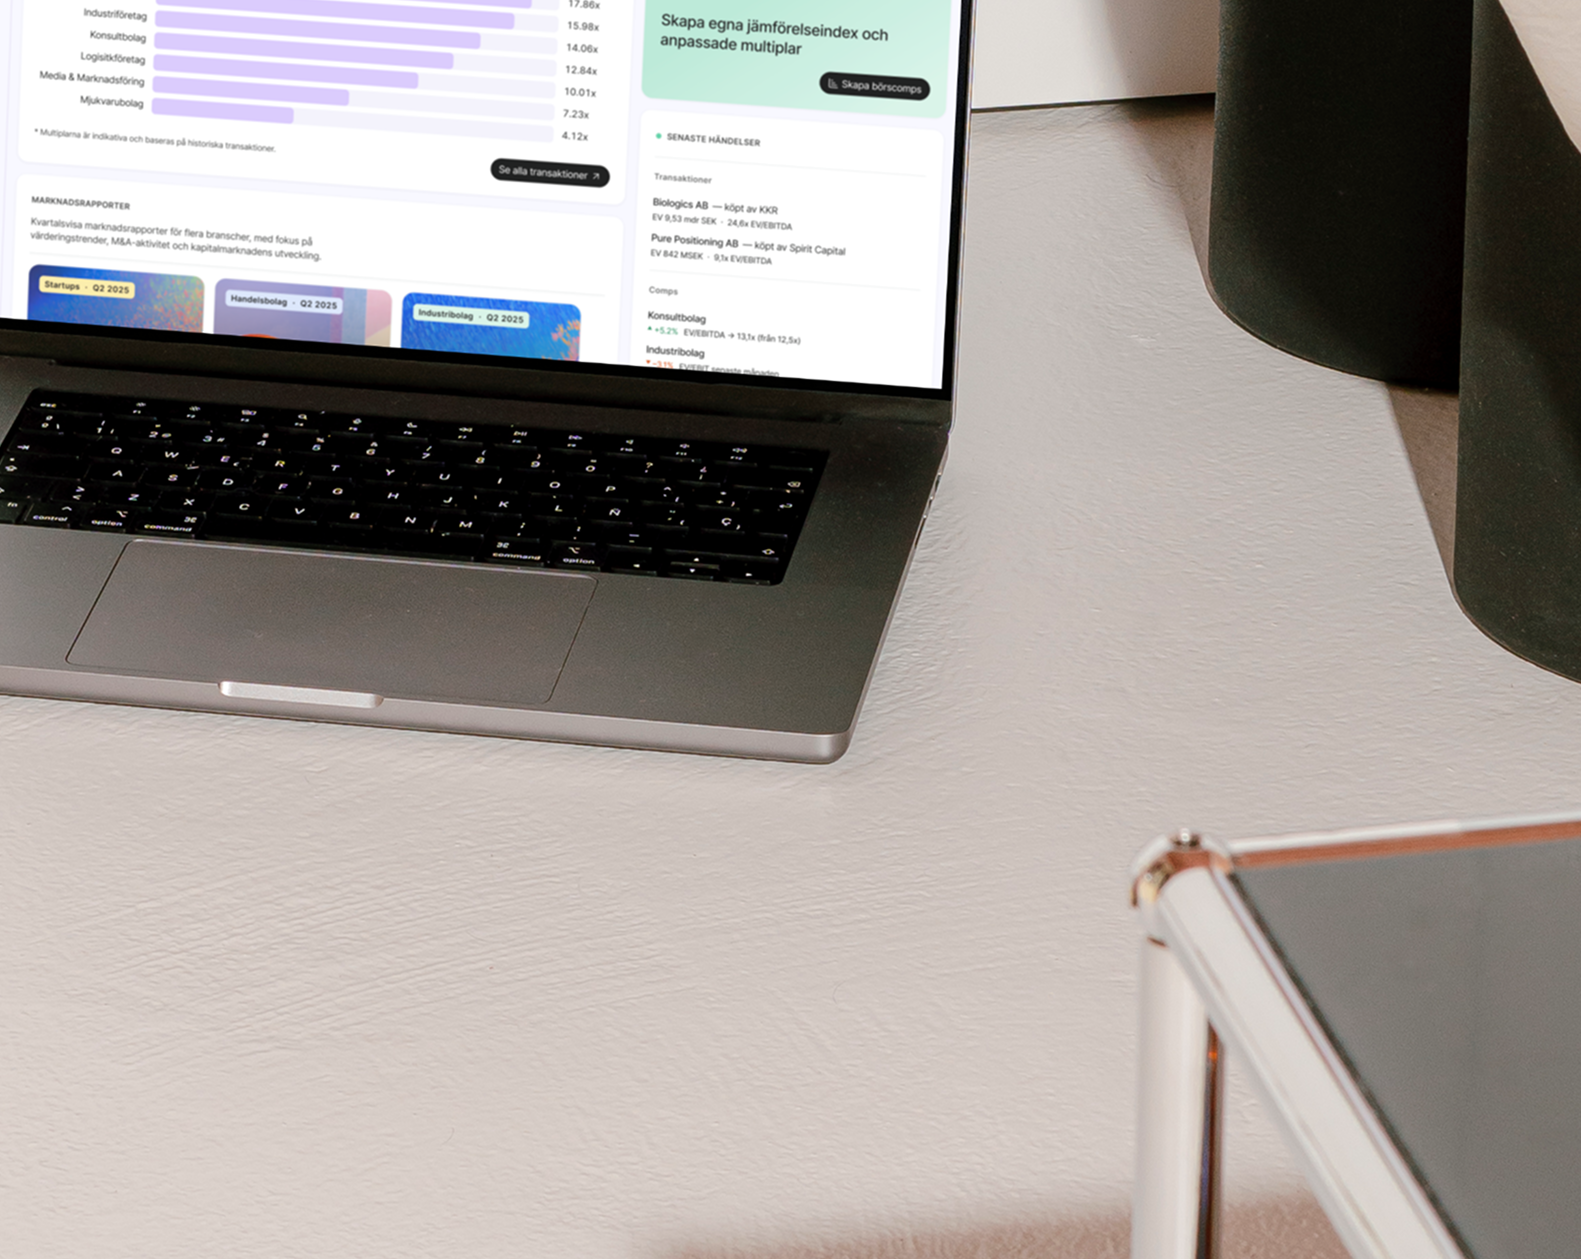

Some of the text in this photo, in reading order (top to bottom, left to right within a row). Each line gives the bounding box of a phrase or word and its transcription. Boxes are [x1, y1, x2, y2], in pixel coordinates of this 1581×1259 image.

[569, 0, 600, 9] 17.86x
[83, 8, 148, 23] Industriföretag
[568, 21, 599, 31] 15.98x
[661, 13, 888, 41] Skapa egna jämförelseindex och
[90, 30, 147, 45] Konsultbolag
[567, 43, 598, 53] 14.06x
[660, 35, 802, 56] anpassade multiplar
[566, 65, 597, 75] 12.84x
[39, 70, 145, 88] Media & Marknadsföring
[565, 87, 596, 97] 10.01x
[842, 79, 922, 95] Skapa börscomps
[80, 95, 144, 110] Mjukvarubolag
[563, 109, 589, 119] 7.23x
[40, 128, 81, 139] Multiplarna
[92, 133, 128, 142] indikativa
[145, 136, 175, 145] baseras
[176, 138, 186, 147] på
[187, 139, 224, 149] historiska
[225, 142, 277, 152] transaktioner.
[562, 131, 588, 141] 4.12x
[667, 133, 761, 147] SENASTE HÄNDELSER
[499, 165, 588, 180] Se alla transaktioner
[654, 172, 712, 184] Transaktioner
[31, 196, 130, 210] MARKNADSRAPPORTER
[653, 197, 694, 210] Biologics
[695, 201, 709, 210] AB
[724, 203, 744, 214] köpt
[759, 206, 778, 215] KKR
[652, 213, 663, 221] EV
[664, 214, 682, 223] 9,53
[683, 216, 700, 224] mdr
[701, 216, 717, 225] SEK
[750, 220, 793, 230] EV/EBITDA
[30, 217, 313, 247] Kvartalsvisa marknadsrapporter för flera branscher, med fokus på
[30, 231, 321, 262] värderingstrender, M&A-aktivitet och kapitalmarknadens utveckling.
[651, 233, 672, 243] Pure
[674, 235, 724, 249] Positioning
[725, 239, 739, 248] AB
[754, 241, 774, 252] köpt
[789, 243, 813, 254] Spirit
[814, 245, 846, 256] Capital
[650, 249, 662, 257] EV
[680, 251, 703, 260] MSEK
[730, 254, 772, 265] EV/EBITDA
[44, 280, 130, 294] Startups Q2 2025
[648, 286, 678, 296] Comps
[231, 295, 338, 310] Handelsbolag Q2 2025
[418, 309, 524, 324] Industribolag Q2 2025
[647, 311, 707, 326] Konsultbolag
[655, 326, 678, 335] +5.2%
[683, 328, 726, 339] EV/EBITDA
[757, 334, 776, 342] (från
[646, 345, 705, 360] Industribolag
[144, 524, 192, 532] command
[492, 552, 541, 560] command
